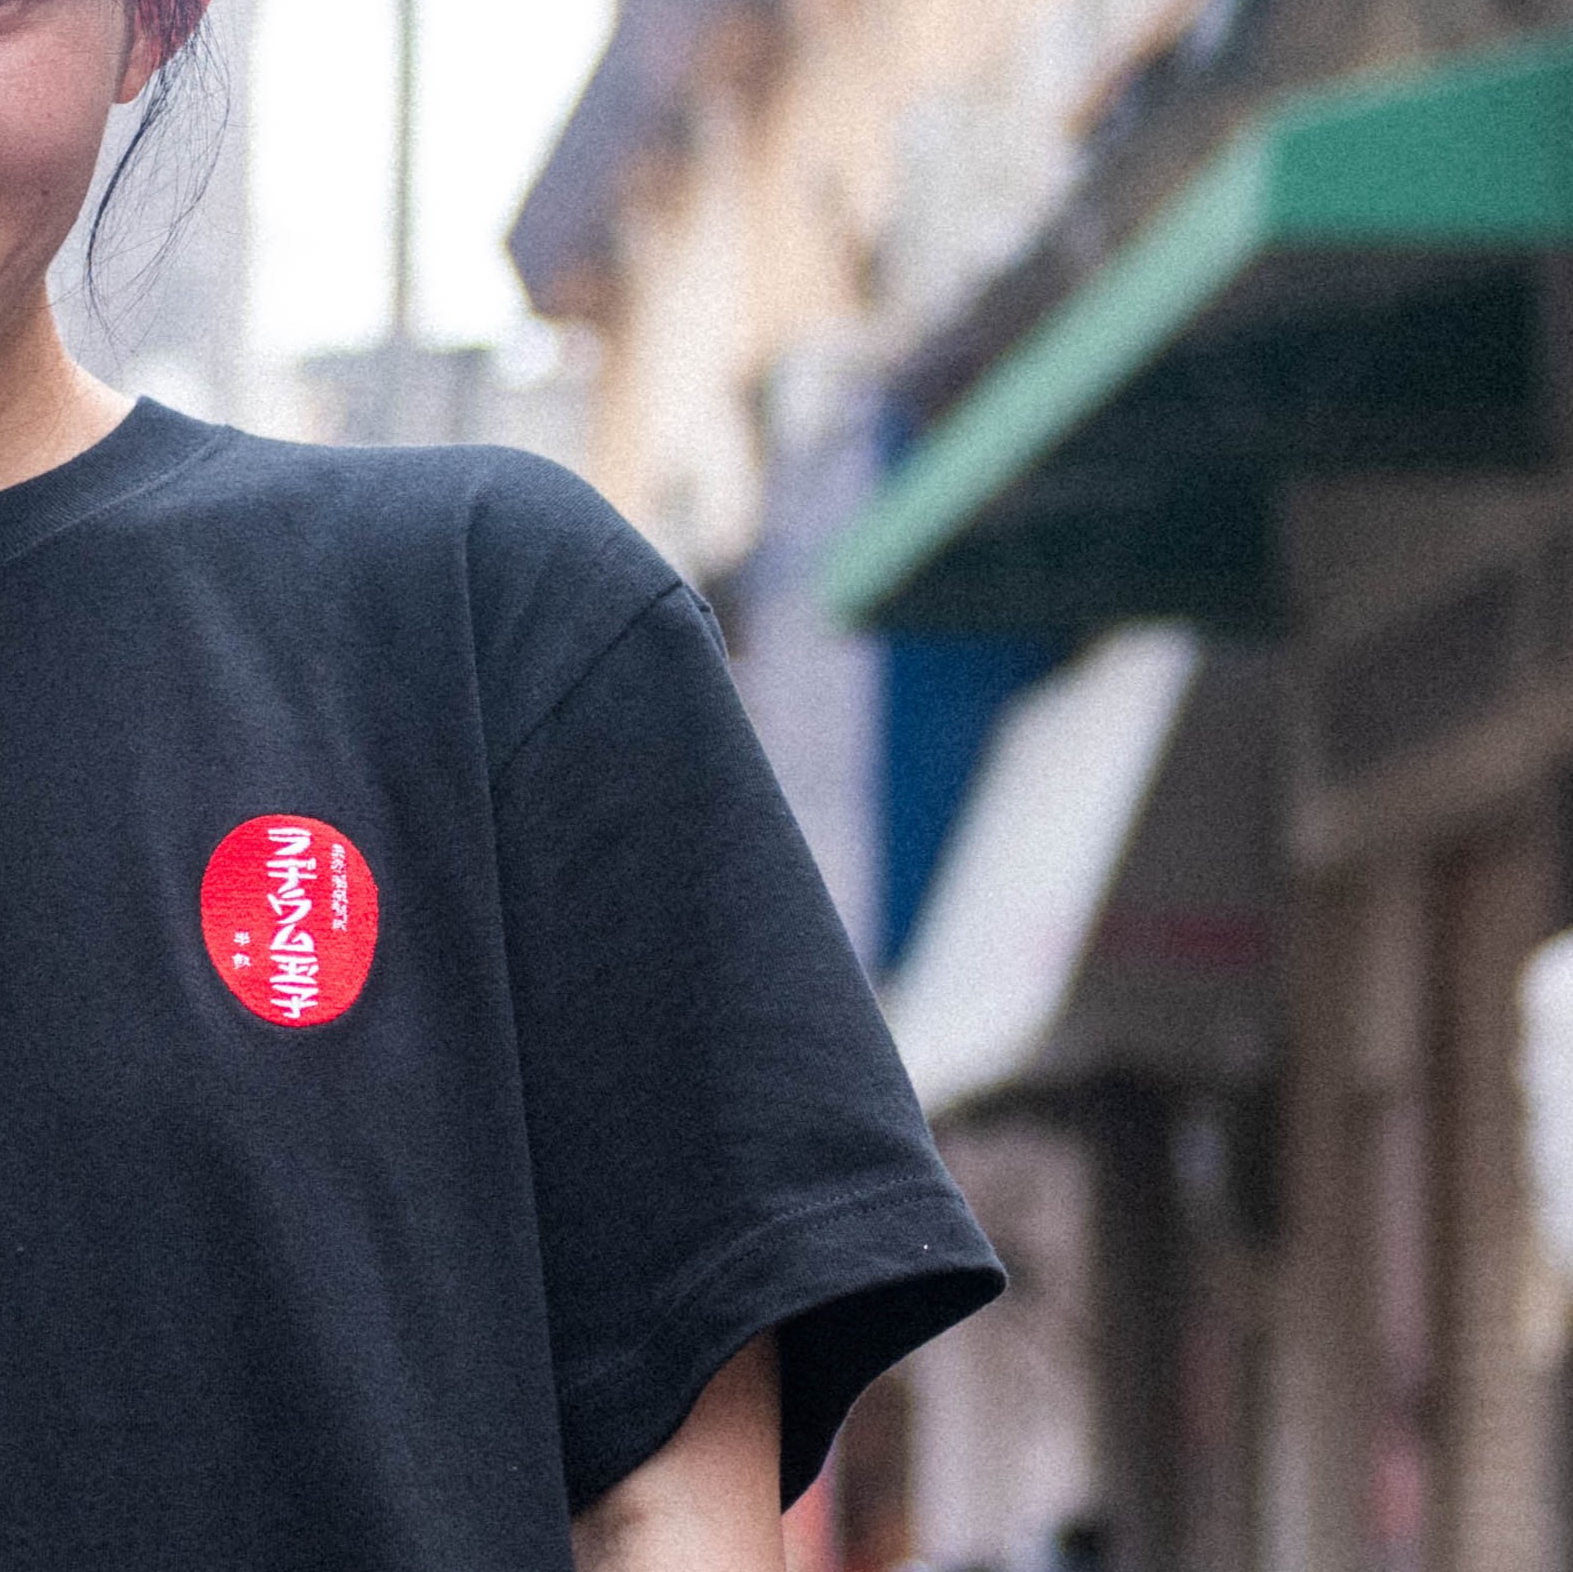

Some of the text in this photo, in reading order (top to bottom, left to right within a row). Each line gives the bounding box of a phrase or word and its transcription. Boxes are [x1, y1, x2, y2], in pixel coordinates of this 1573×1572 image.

[266, 827, 320, 1019] ラヂウム玉子
